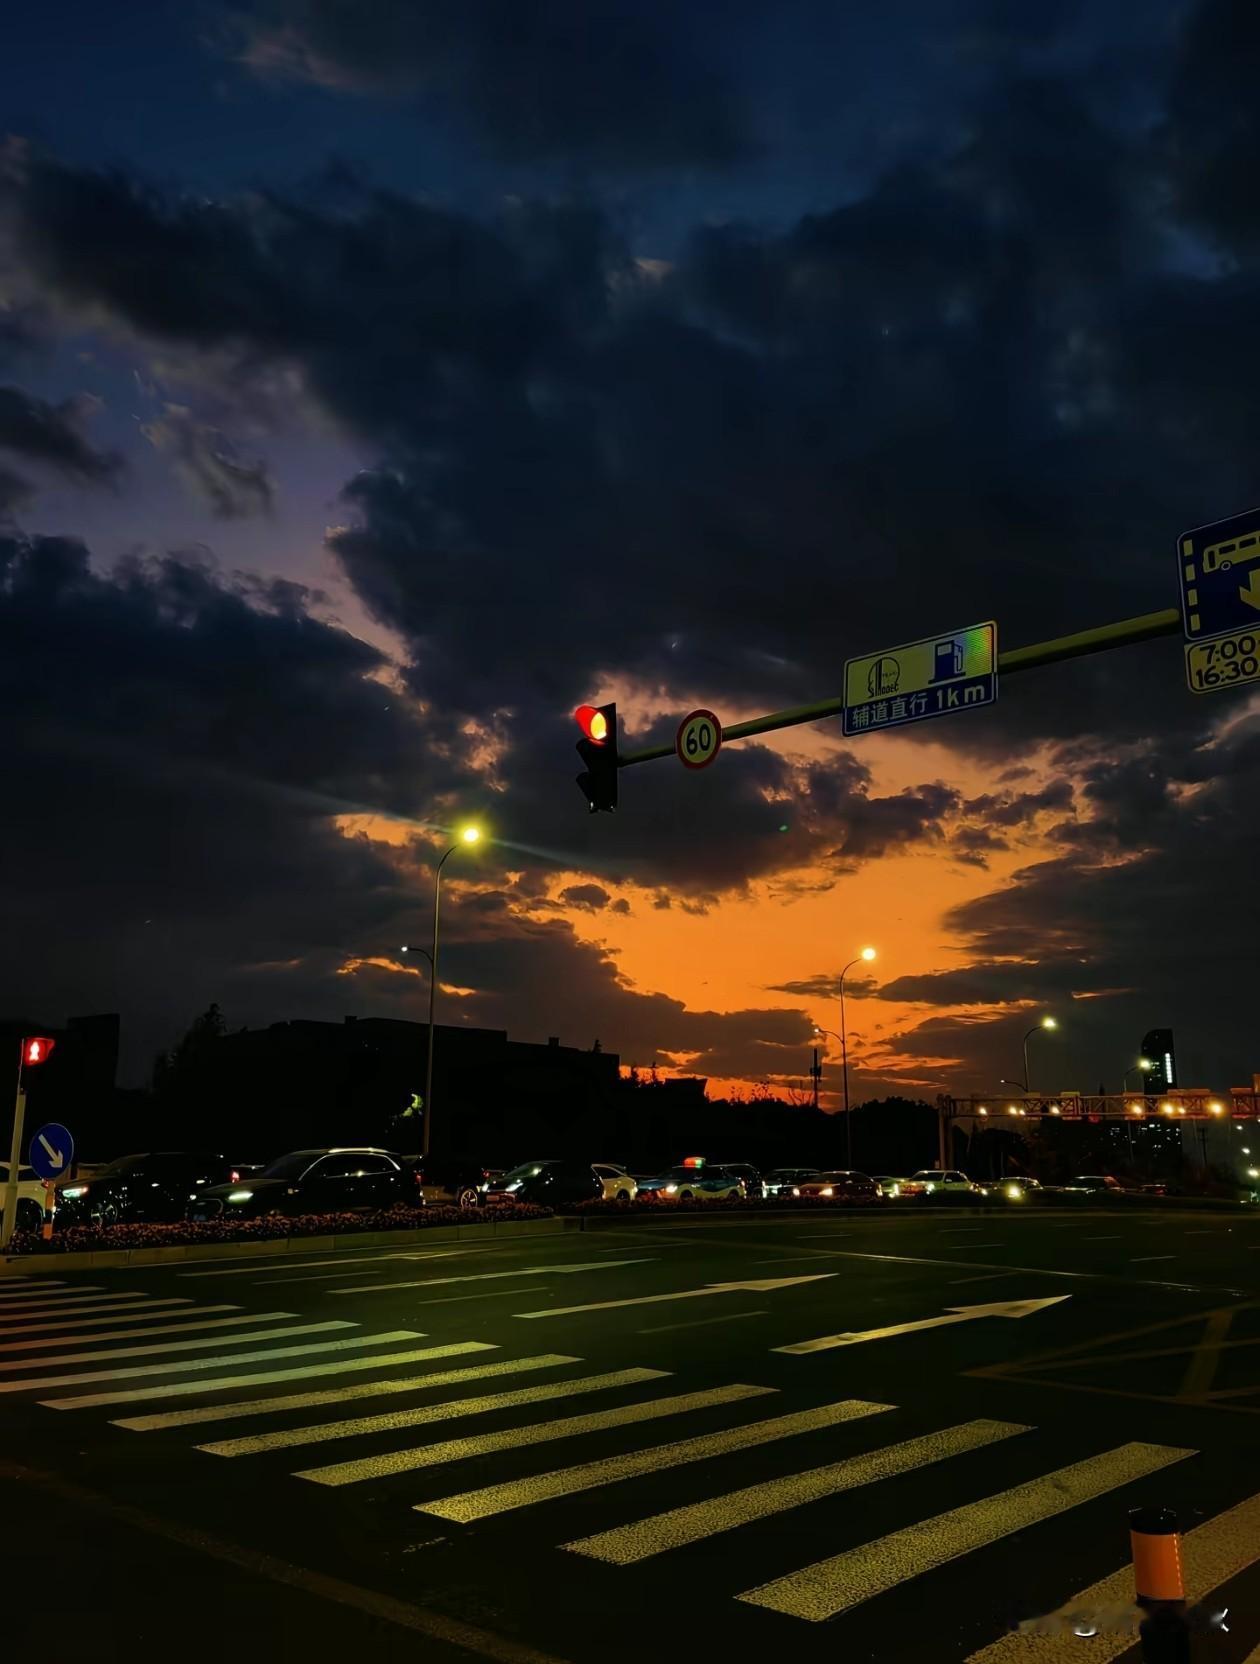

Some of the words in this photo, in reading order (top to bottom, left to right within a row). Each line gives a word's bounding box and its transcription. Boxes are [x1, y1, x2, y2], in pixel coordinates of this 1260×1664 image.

[852, 692, 929, 728] 辅道直行
[936, 684, 986, 709] 1km
[686, 723, 711, 755] 60
